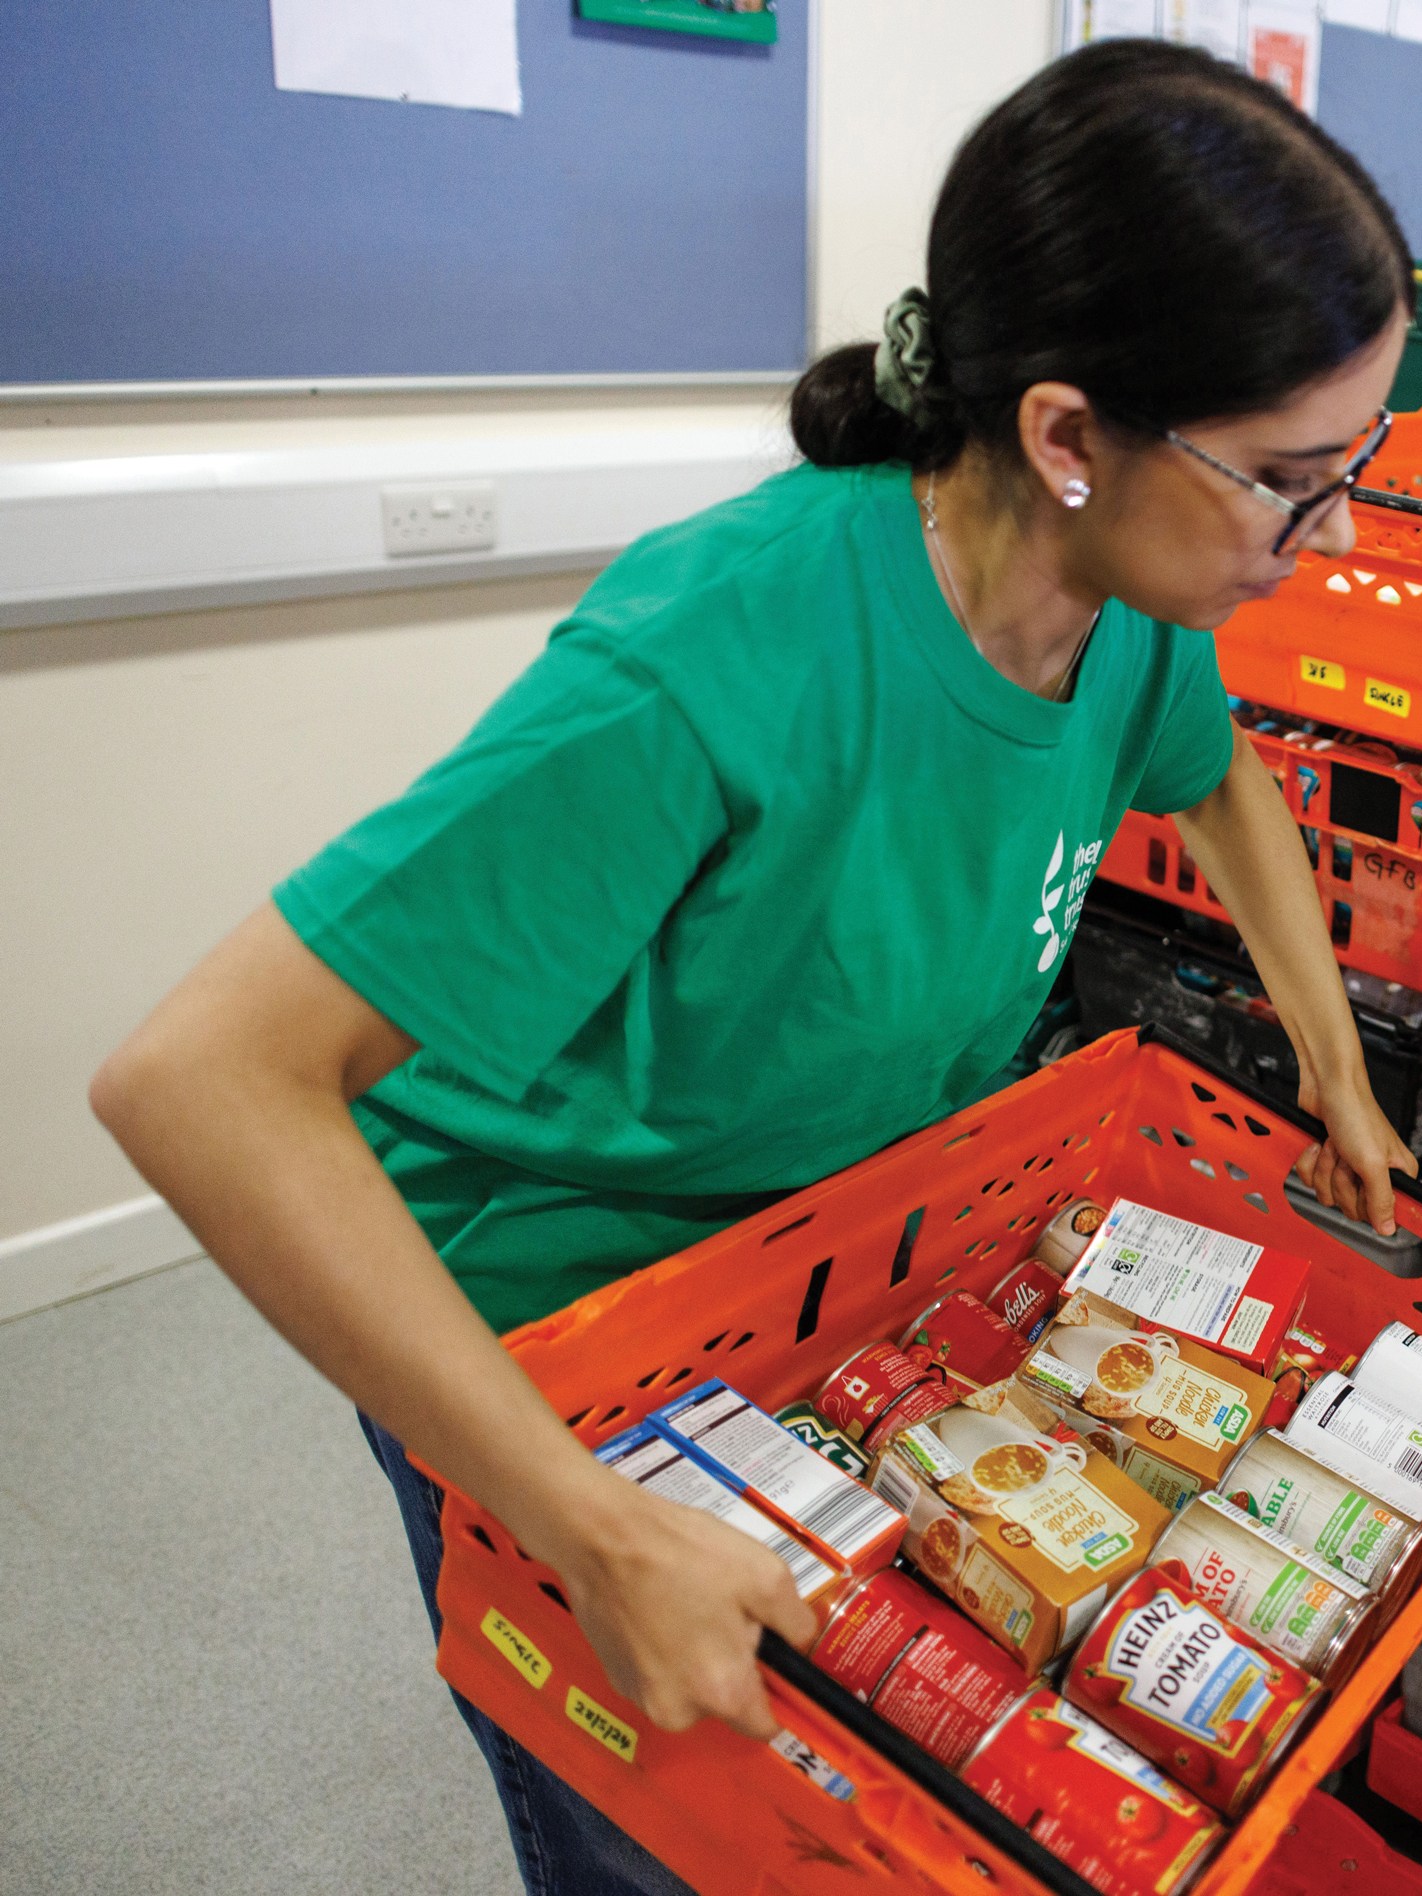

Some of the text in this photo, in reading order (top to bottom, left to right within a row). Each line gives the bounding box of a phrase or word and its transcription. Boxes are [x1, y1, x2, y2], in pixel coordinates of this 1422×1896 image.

[1220, 1303, 1232, 1321] PREPARE
[1160, 1374, 1185, 1409] MUG SOUP
[1174, 1380, 1202, 1415] Noodle
[1302, 1389, 1324, 1418] ESSENTIAL
[1307, 1391, 1329, 1420] WAITROSE
[1192, 1387, 1221, 1428] Chicken
[1222, 1408, 1244, 1434] ASDA
[1320, 1404, 1336, 1425] NUTRITION
[1028, 1490, 1073, 1520] MUG SOUP
[1041, 1497, 1088, 1532] Noodle
[1055, 1509, 1106, 1546] Chicken
[1089, 1537, 1122, 1560] ASDA
[1201, 1550, 1224, 1580] OF
[848, 1599, 870, 1622] HEARTS
[1117, 1601, 1177, 1667] HEINZ
[1154, 1630, 1184, 1668] CREAM OF
[1148, 1625, 1221, 1706] TOMATO
[1192, 1661, 1211, 1682] SOUP
